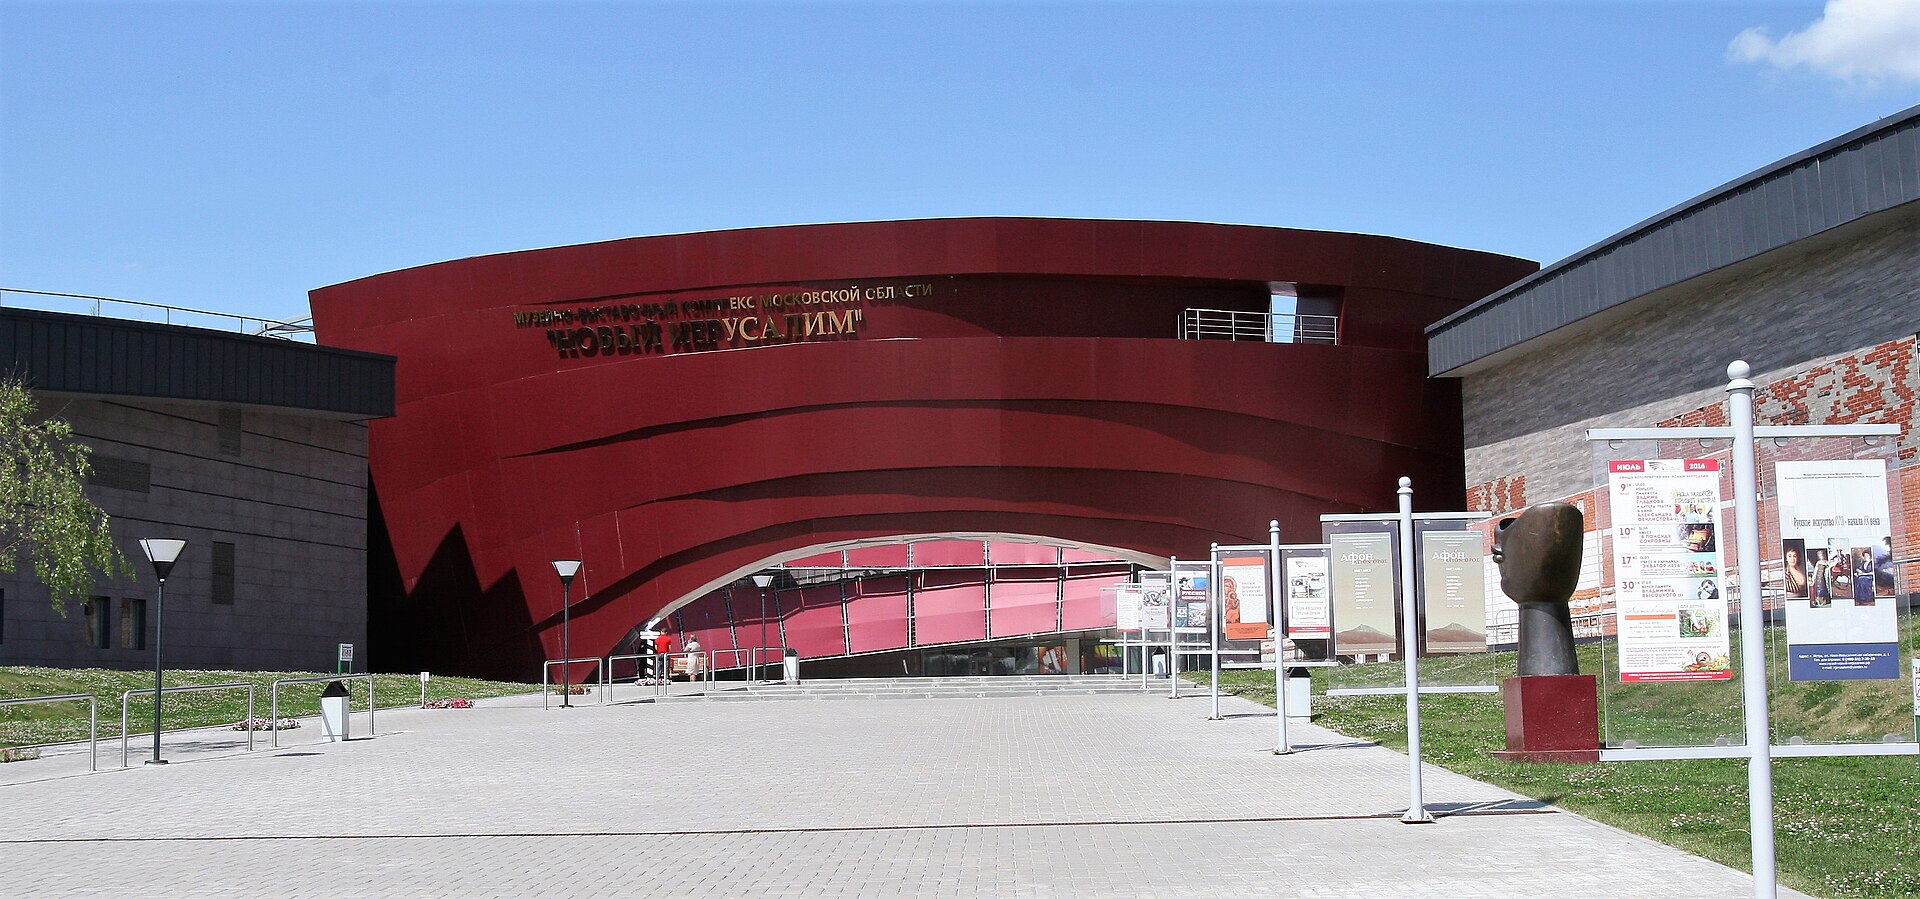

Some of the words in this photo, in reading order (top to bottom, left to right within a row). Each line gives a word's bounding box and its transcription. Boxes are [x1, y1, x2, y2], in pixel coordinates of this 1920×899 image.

[760, 285, 860, 309] МОСКОВСКОЙ
[865, 283, 932, 301] ОБЛАСТИ
[668, 309, 863, 349] ИЕРУСАЛИМ"
